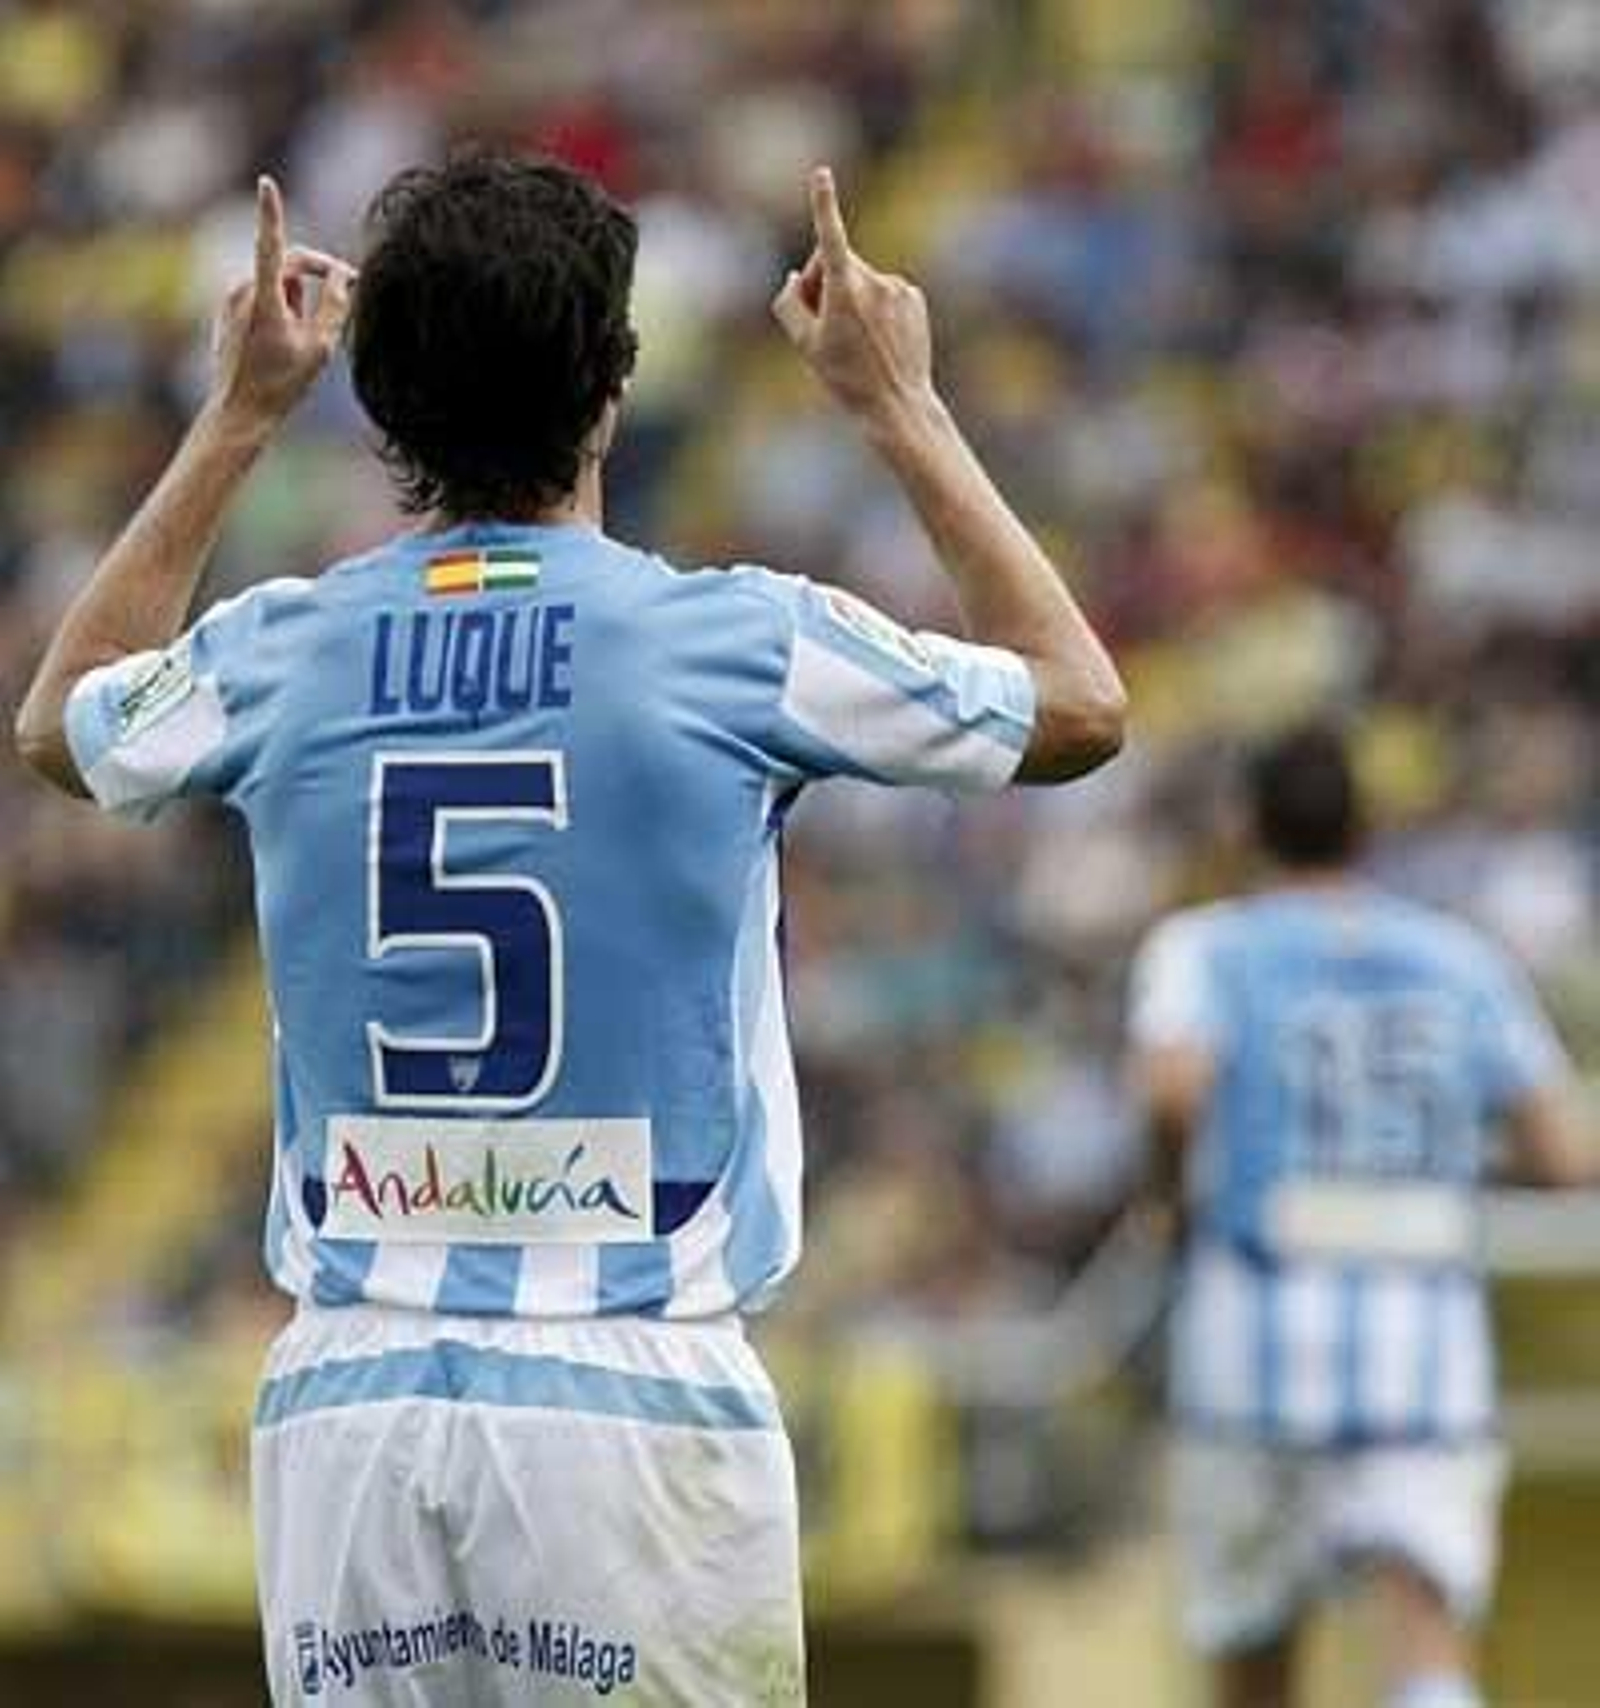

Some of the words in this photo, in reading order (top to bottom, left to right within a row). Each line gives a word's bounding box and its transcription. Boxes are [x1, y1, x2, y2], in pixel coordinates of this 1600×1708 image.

[369, 604, 574, 730] LUQUE
[366, 750, 568, 1112] 5
[331, 1141, 640, 1220] Andalucía
[321, 1611, 488, 1688] Ayuntamien
[490, 1614, 520, 1669] de
[529, 1613, 635, 1695] Málaga
